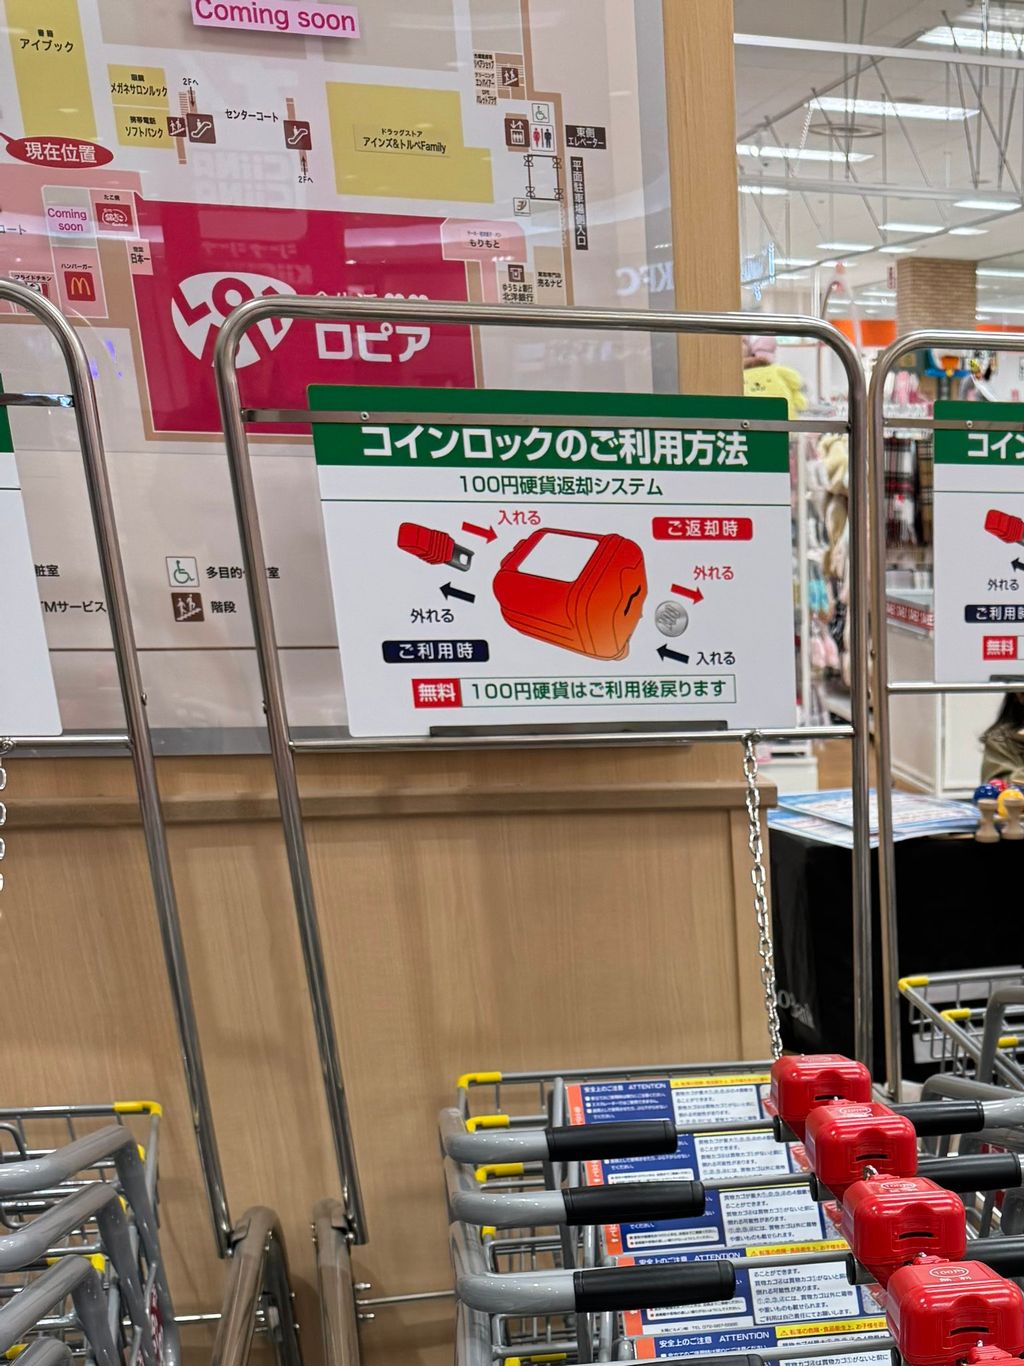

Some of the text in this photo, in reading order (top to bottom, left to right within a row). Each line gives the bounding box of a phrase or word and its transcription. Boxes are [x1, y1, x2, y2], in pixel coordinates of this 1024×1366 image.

[195, 0, 356, 33] Coming soon
[20, 38, 74, 53] アイブック
[225, 108, 279, 123] センターコート
[125, 126, 164, 139] ソフトバンク
[25, 141, 98, 164] 現在位置
[47, 207, 88, 221] Coming
[58, 222, 84, 232] soon
[469, 239, 501, 249] もりもと
[130, 253, 151, 264] 日本一
[316, 321, 431, 363] ロピア
[361, 424, 749, 467] コインロックのご利用方法
[459, 474, 664, 497] 100円硬貨返却システム
[498, 510, 541, 526] 入れる
[667, 520, 739, 538] ご返却時
[693, 565, 735, 581] 外れる
[987, 578, 1020, 592] 外れる
[211, 601, 237, 614] 階段
[410, 608, 455, 624] 外れる
[398, 642, 474, 661] ご利用時
[986, 638, 1014, 656] 無料
[696, 650, 736, 667] 入れる
[417, 681, 727, 703] 無料 100円硬貨はご利用後戻ります
[628, 1082, 667, 1091] ATTENTION
[659, 1335, 712, 1348] 安全上のご注意
[719, 1331, 770, 1343] ATTENTION
